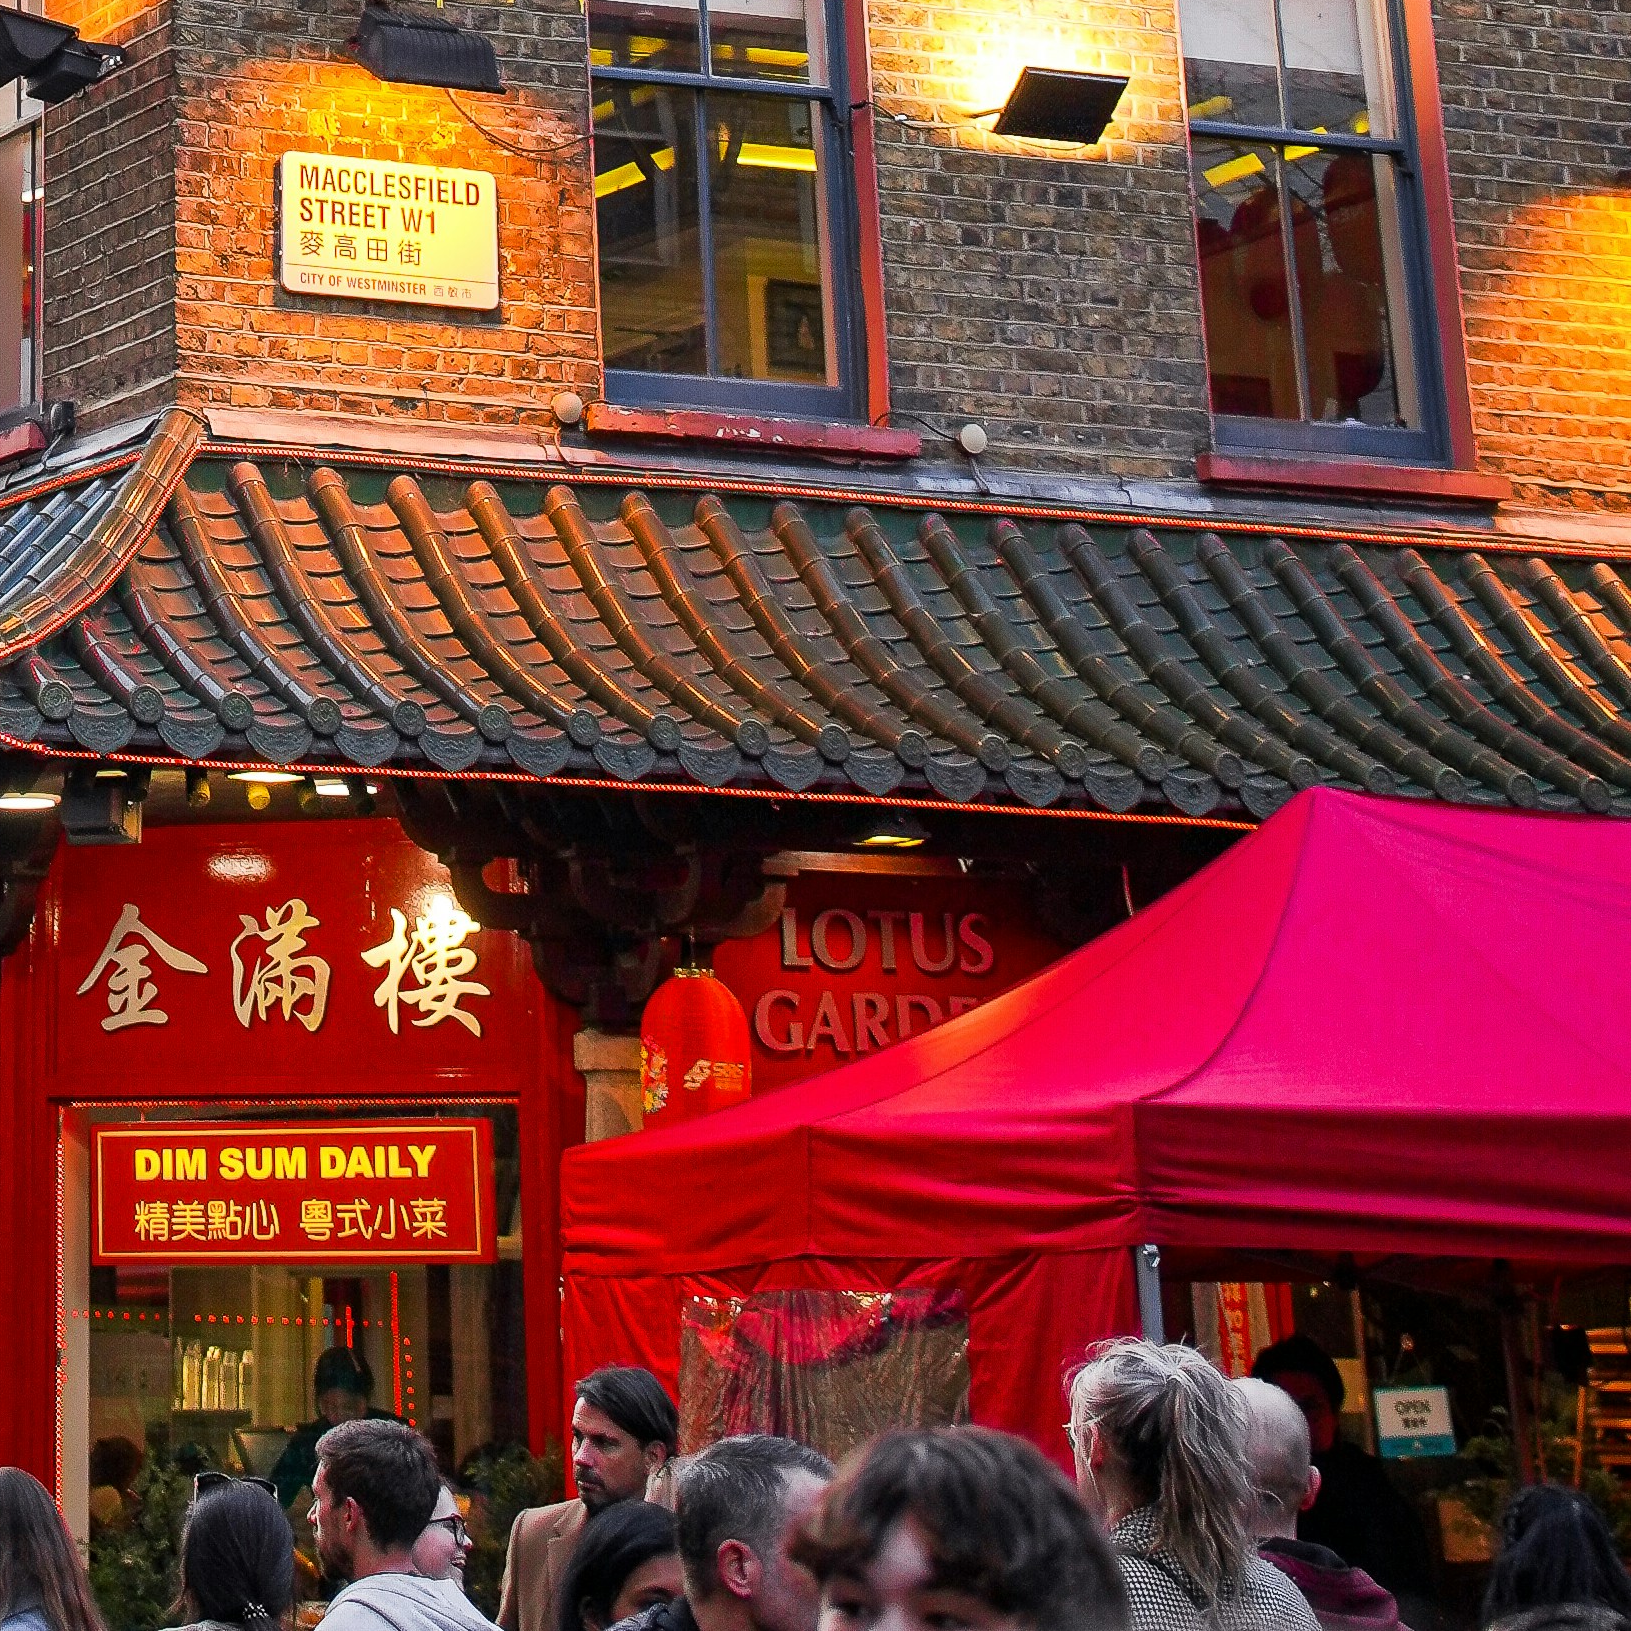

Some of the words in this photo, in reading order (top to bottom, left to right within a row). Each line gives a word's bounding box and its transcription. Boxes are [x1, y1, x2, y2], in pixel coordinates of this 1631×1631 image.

[300, 164, 480, 206] MACCLESFIELD
[300, 198, 391, 230] STREET
[401, 207, 436, 234] W1
[300, 272, 324, 285] CITY
[328, 274, 342, 287] OF
[346, 276, 427, 296] WESTMINSTER
[780, 906, 995, 974] LOTUS
[76, 895, 492, 1038] 金滿樓
[754, 989, 981, 1053] GARD
[134, 1148, 208, 1182] DIM
[219, 1147, 308, 1181] SUM
[319, 1145, 437, 1180] DAILY
[134, 1199, 281, 1242] 精美點心
[299, 1198, 449, 1242] 粵式小菜
